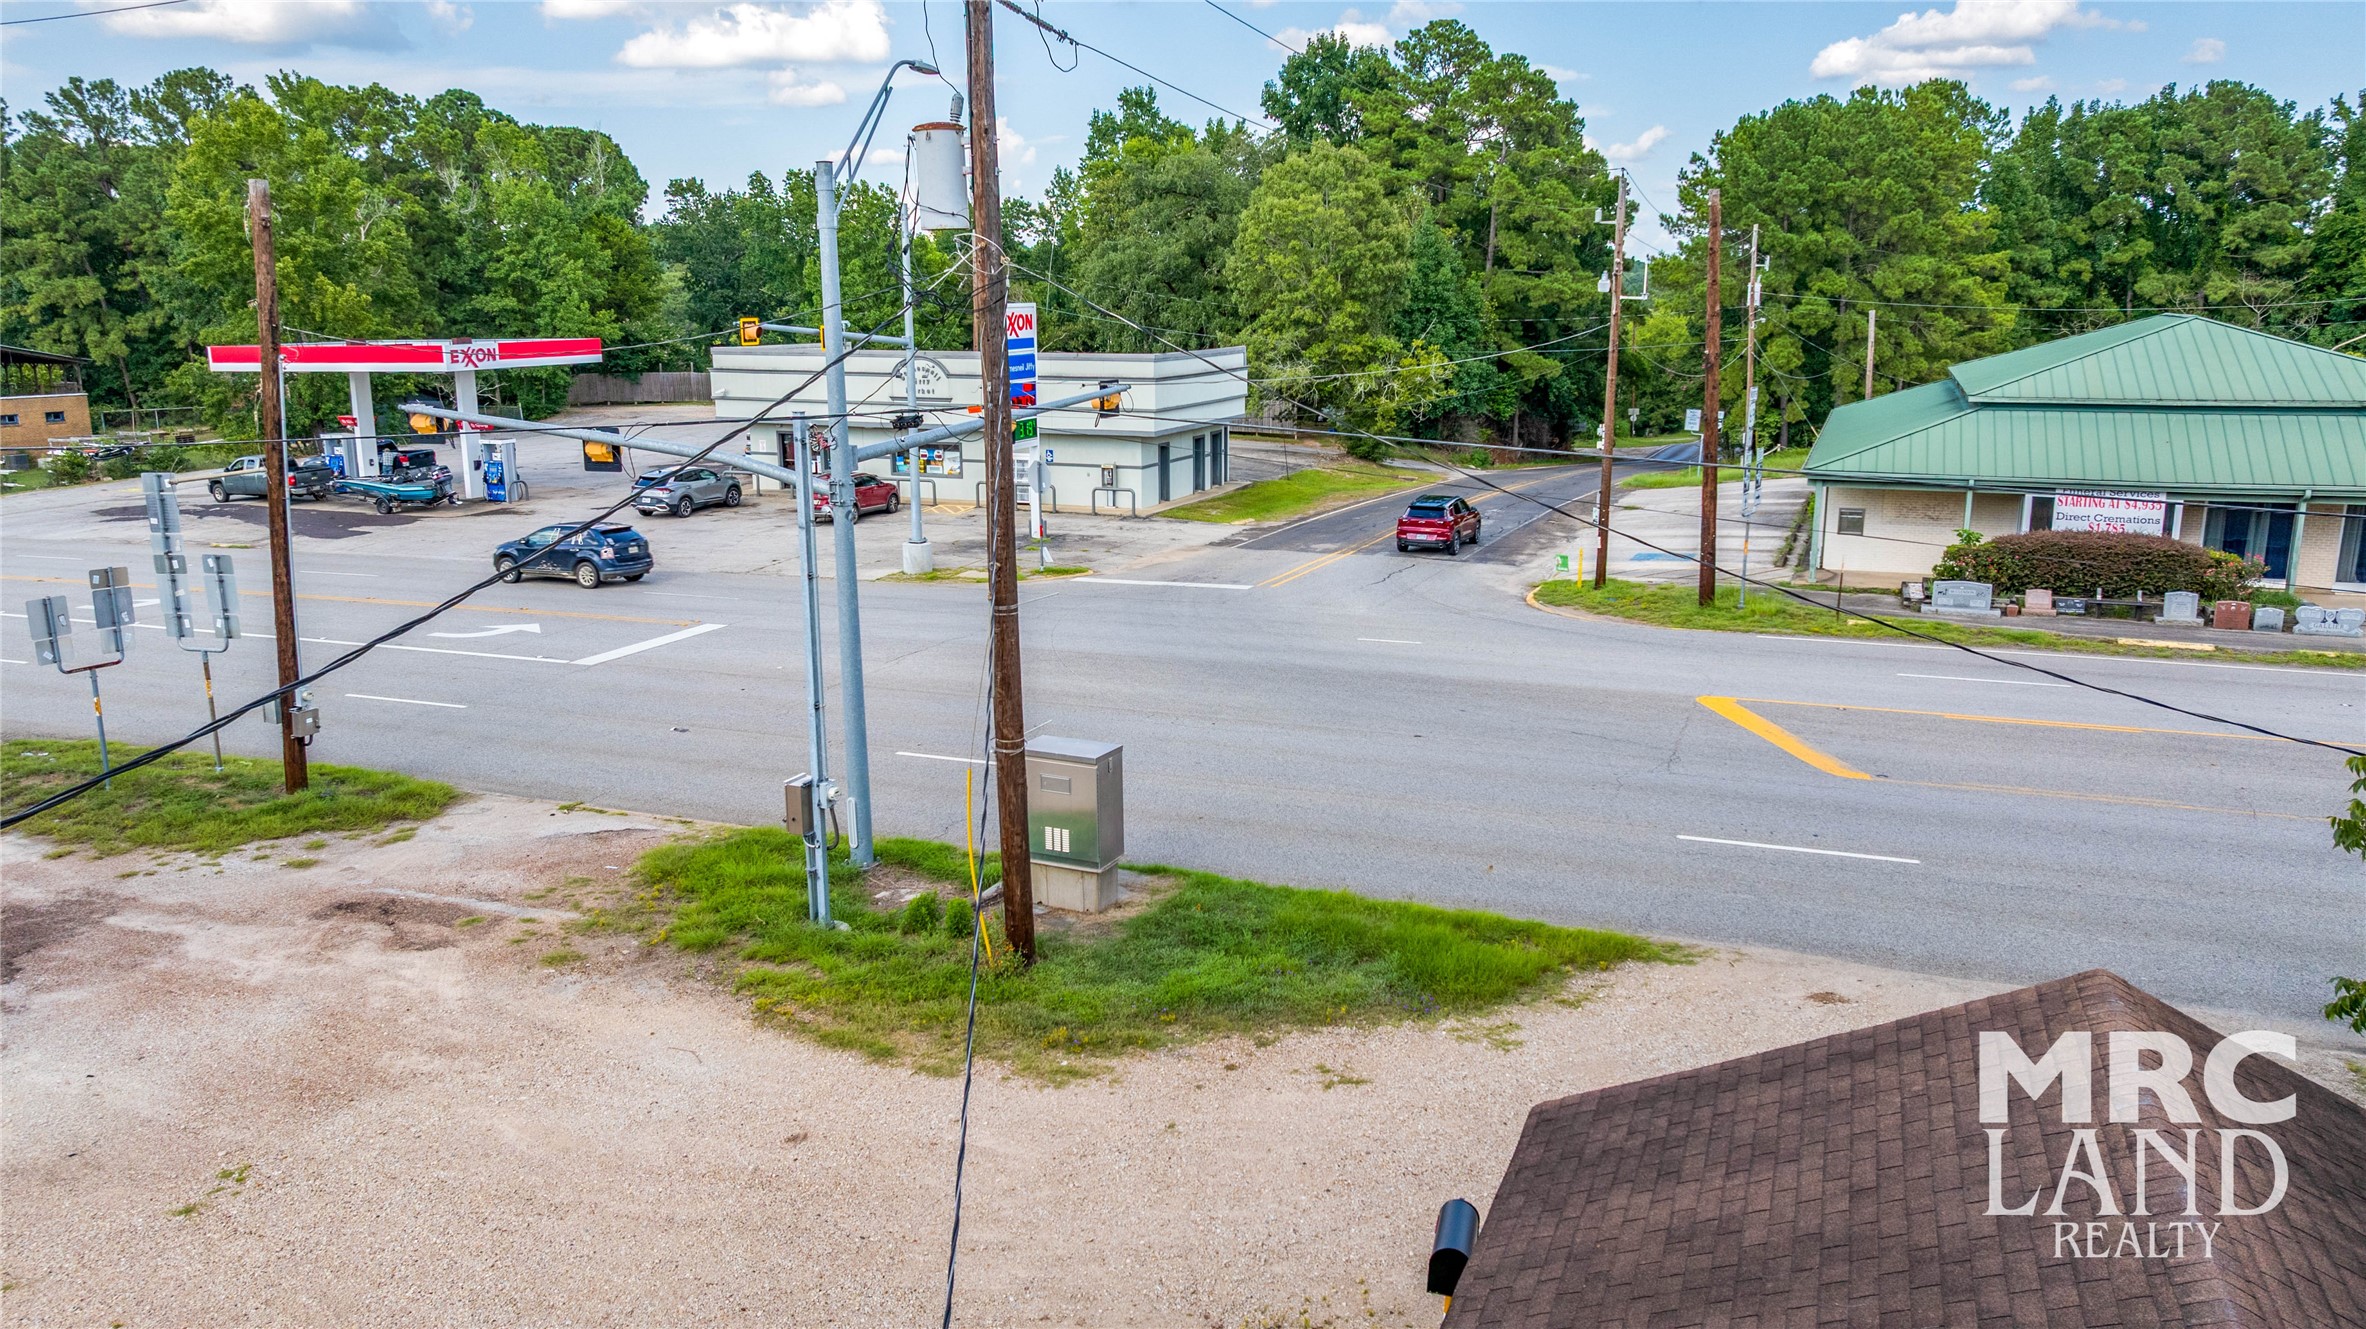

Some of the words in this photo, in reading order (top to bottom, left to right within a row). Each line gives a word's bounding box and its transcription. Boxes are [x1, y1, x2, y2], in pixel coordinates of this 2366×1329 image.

[1007, 312, 1033, 337] XXON
[450, 346, 497, 368] EXXON
[2110, 489, 2160, 498] Services
[2057, 494, 2105, 508] STARTING
[2056, 512, 2091, 522] Direct
[2094, 514, 2161, 525] Cremations
[2089, 521, 2126, 533] $1785
